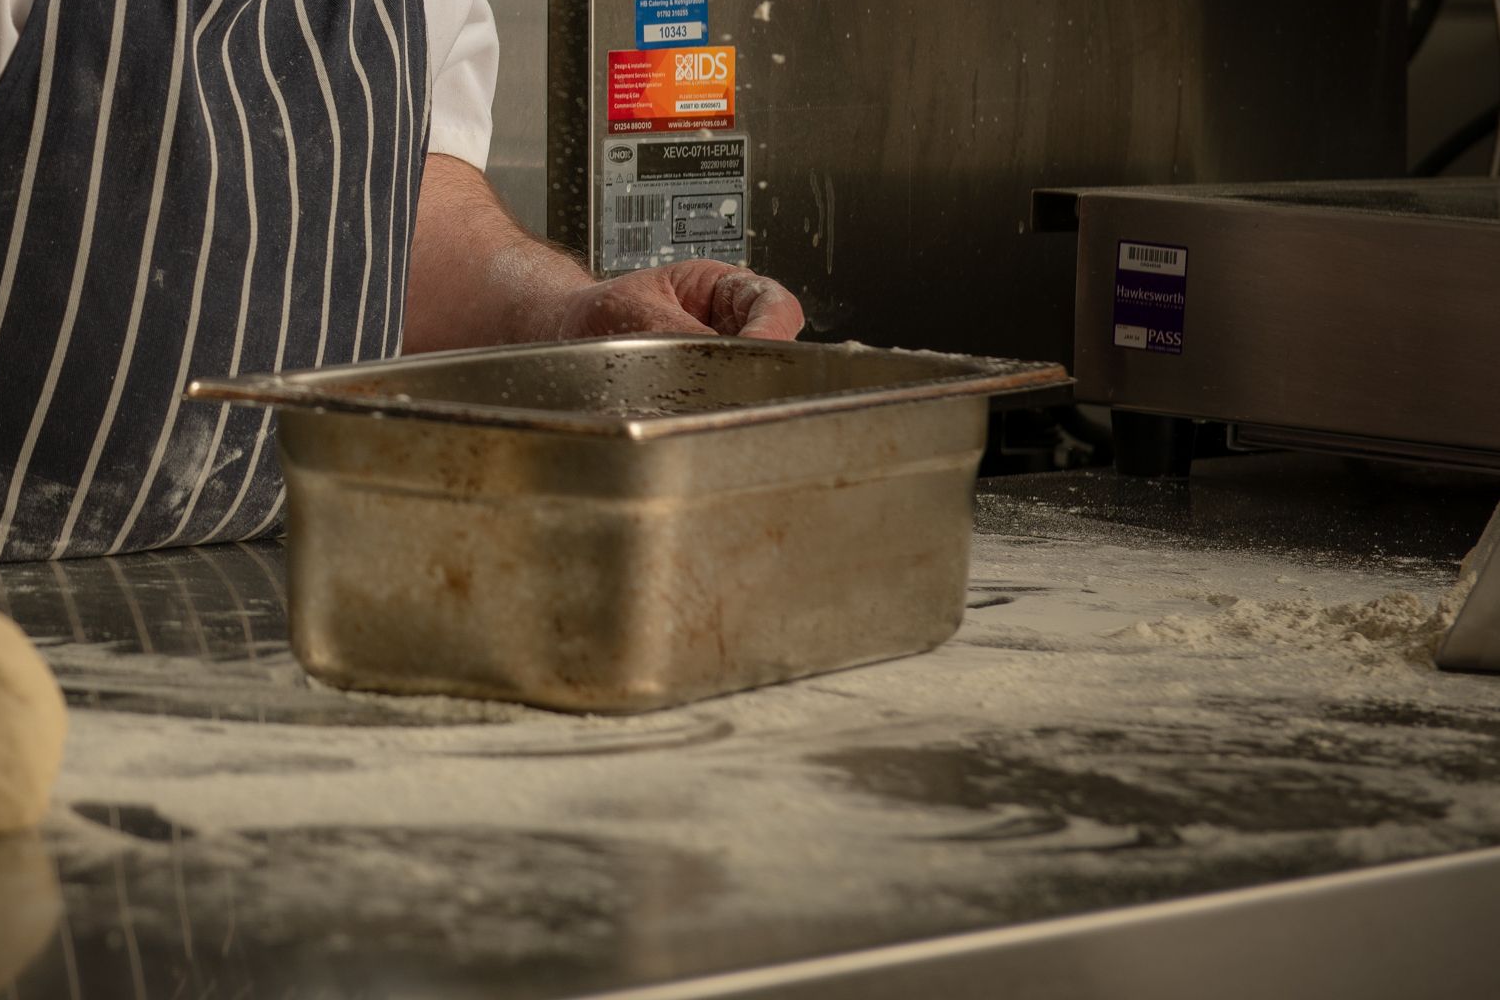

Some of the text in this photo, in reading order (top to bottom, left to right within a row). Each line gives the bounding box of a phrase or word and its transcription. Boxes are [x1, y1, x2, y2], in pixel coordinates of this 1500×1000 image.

[640, 0, 648, 8] HB
[649, 0, 669, 7] Catering
[660, 25, 687, 39] 10343
[693, 52, 728, 81] IDS
[614, 121, 652, 131] 01254 880010
[668, 119, 728, 129] www.ids-services.co.uk
[663, 144, 739, 159] XEVC-0711-EPLM
[678, 202, 713, 211] Segurança
[1116, 284, 1184, 305] Hawkesworth
[1148, 328, 1182, 347] PASS
